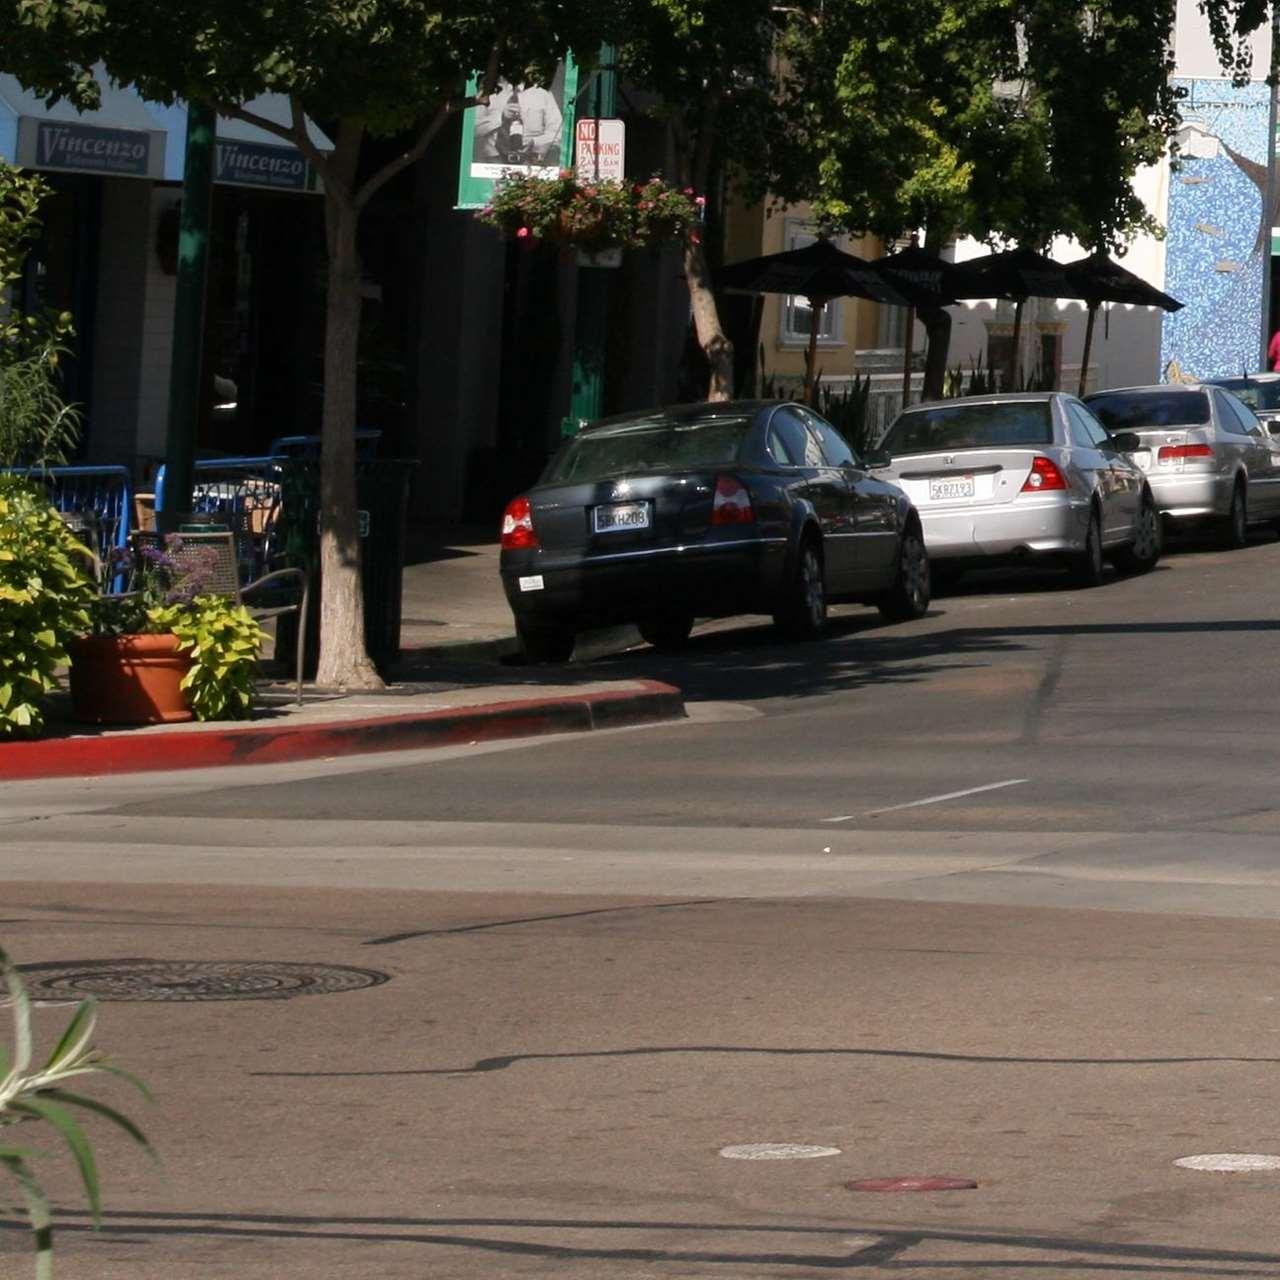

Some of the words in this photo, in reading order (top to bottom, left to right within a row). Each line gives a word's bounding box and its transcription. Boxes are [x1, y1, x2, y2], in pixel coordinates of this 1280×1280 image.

[41, 126, 146, 164] Vincenzo
[215, 144, 301, 177] Vincenzo
[581, 143, 619, 156] PAKING
